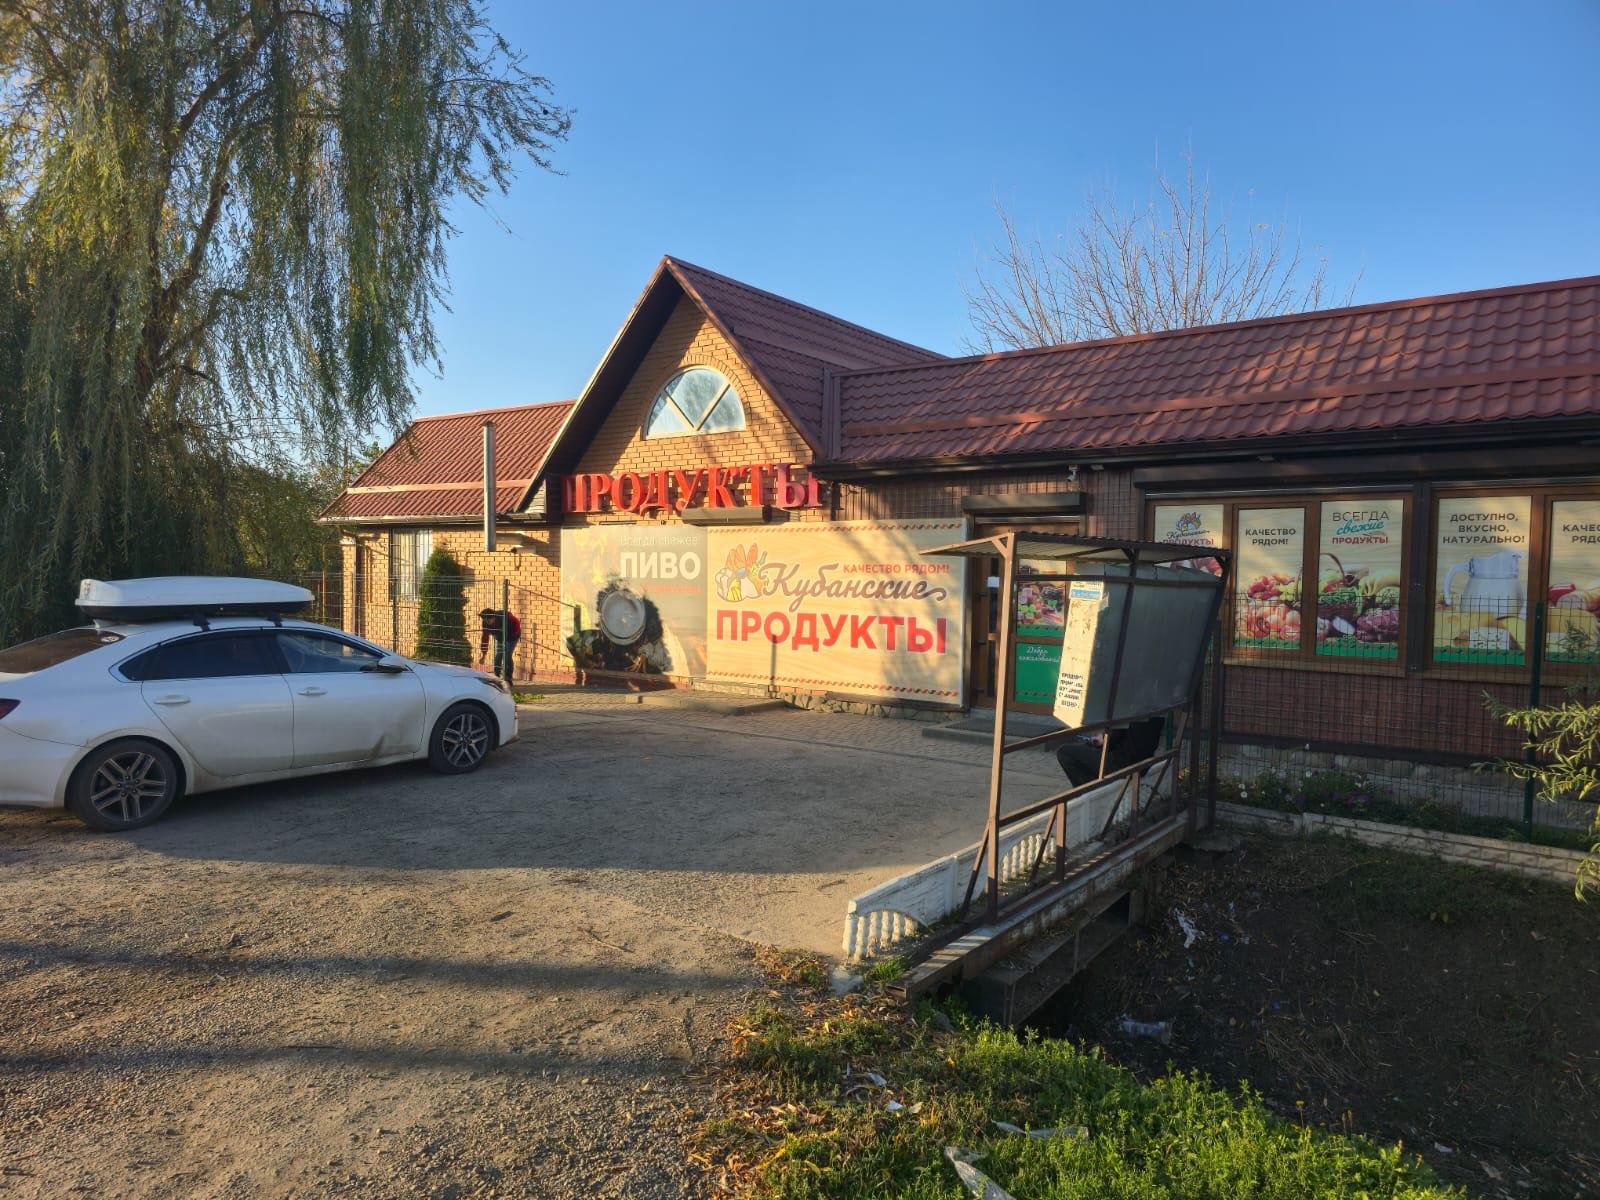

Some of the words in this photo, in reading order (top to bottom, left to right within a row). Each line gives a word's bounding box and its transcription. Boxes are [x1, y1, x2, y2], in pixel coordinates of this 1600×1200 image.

[562, 463, 822, 516] ПРОДУКТЫ
[1332, 511, 1390, 522] ВСЕГДА
[1450, 513, 1519, 523] ДОСТУПНО,
[1245, 528, 1297, 537] КАЧЕСТВО
[1458, 524, 1510, 534] ВКУСНО,
[1252, 538, 1289, 547] РЯДОМ!
[1332, 535, 1389, 545] ПРОДУКТЫ
[1442, 535, 1525, 545] НАТУРАЛЬНО!
[620, 551, 701, 580] ПИВО
[843, 563, 901, 574] КАЧЕСТВО
[904, 563, 950, 576] РЯДОМ!
[761, 562, 947, 613] Кубанские
[716, 609, 947, 655] ПРОДУКТЫ
